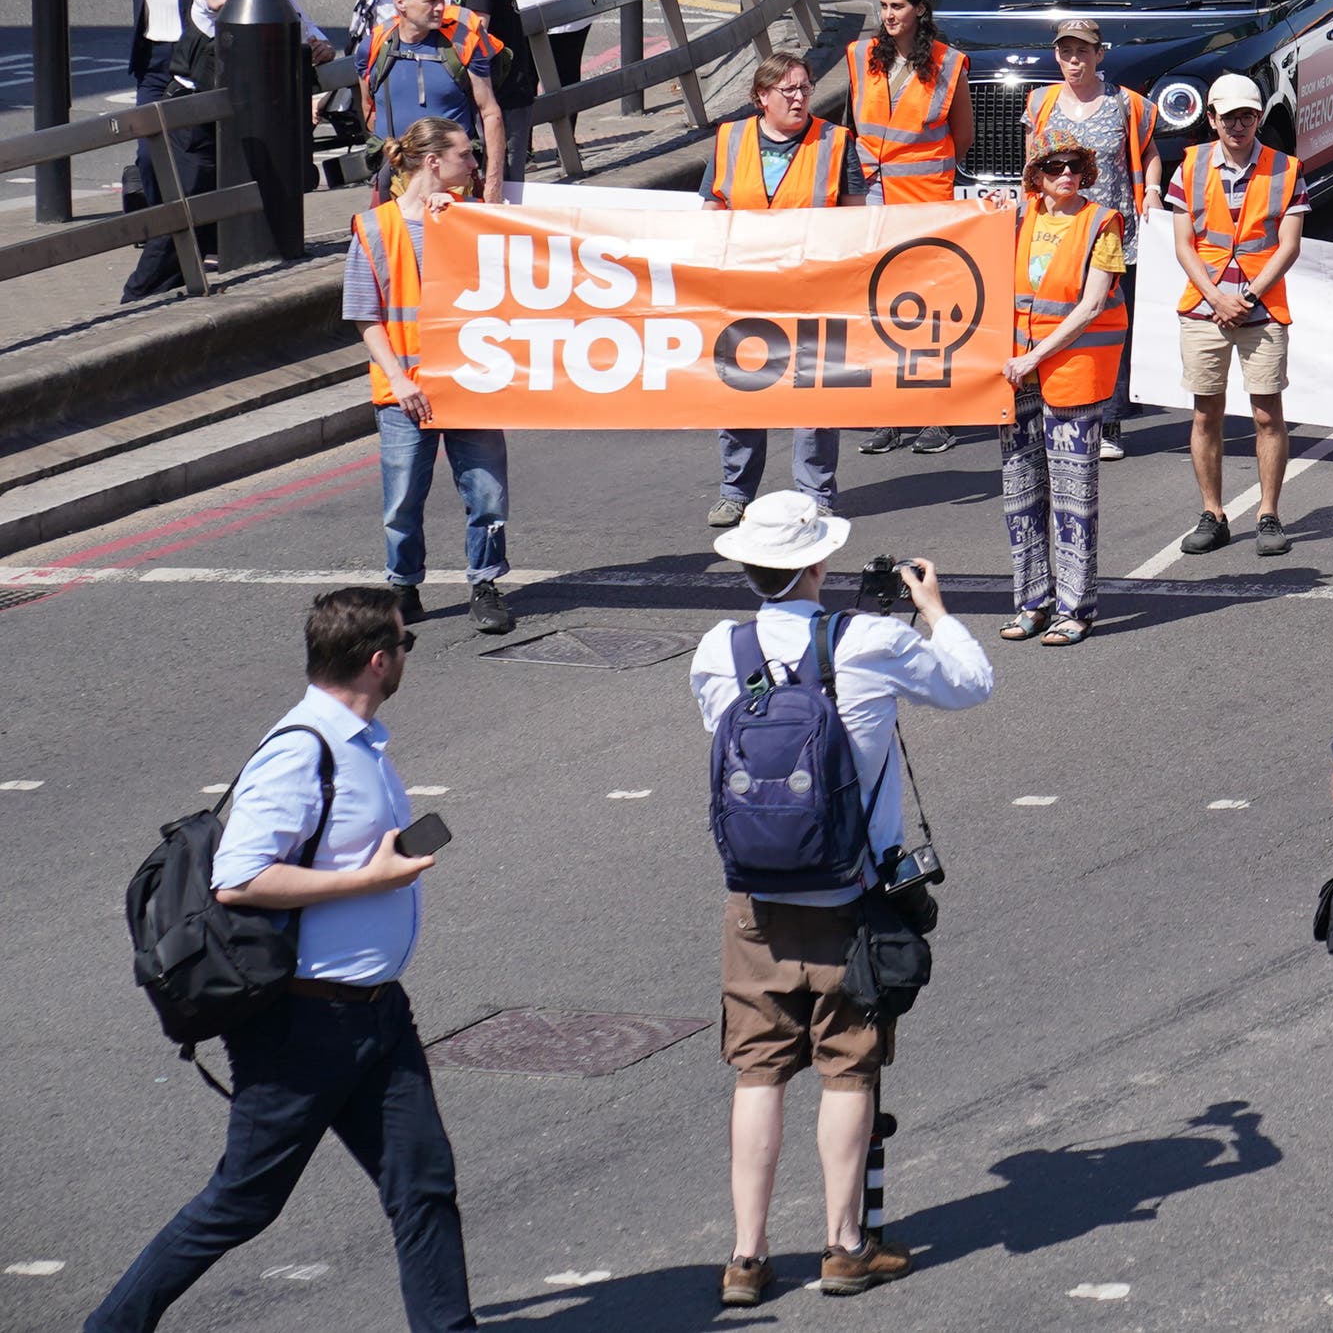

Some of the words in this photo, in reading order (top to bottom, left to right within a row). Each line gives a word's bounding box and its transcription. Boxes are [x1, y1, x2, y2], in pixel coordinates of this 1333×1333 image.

[1301, 81, 1316, 97] BOOK
[453, 233, 695, 312] JUST
[452, 316, 703, 394] STOP
[712, 317, 872, 392] OIL
